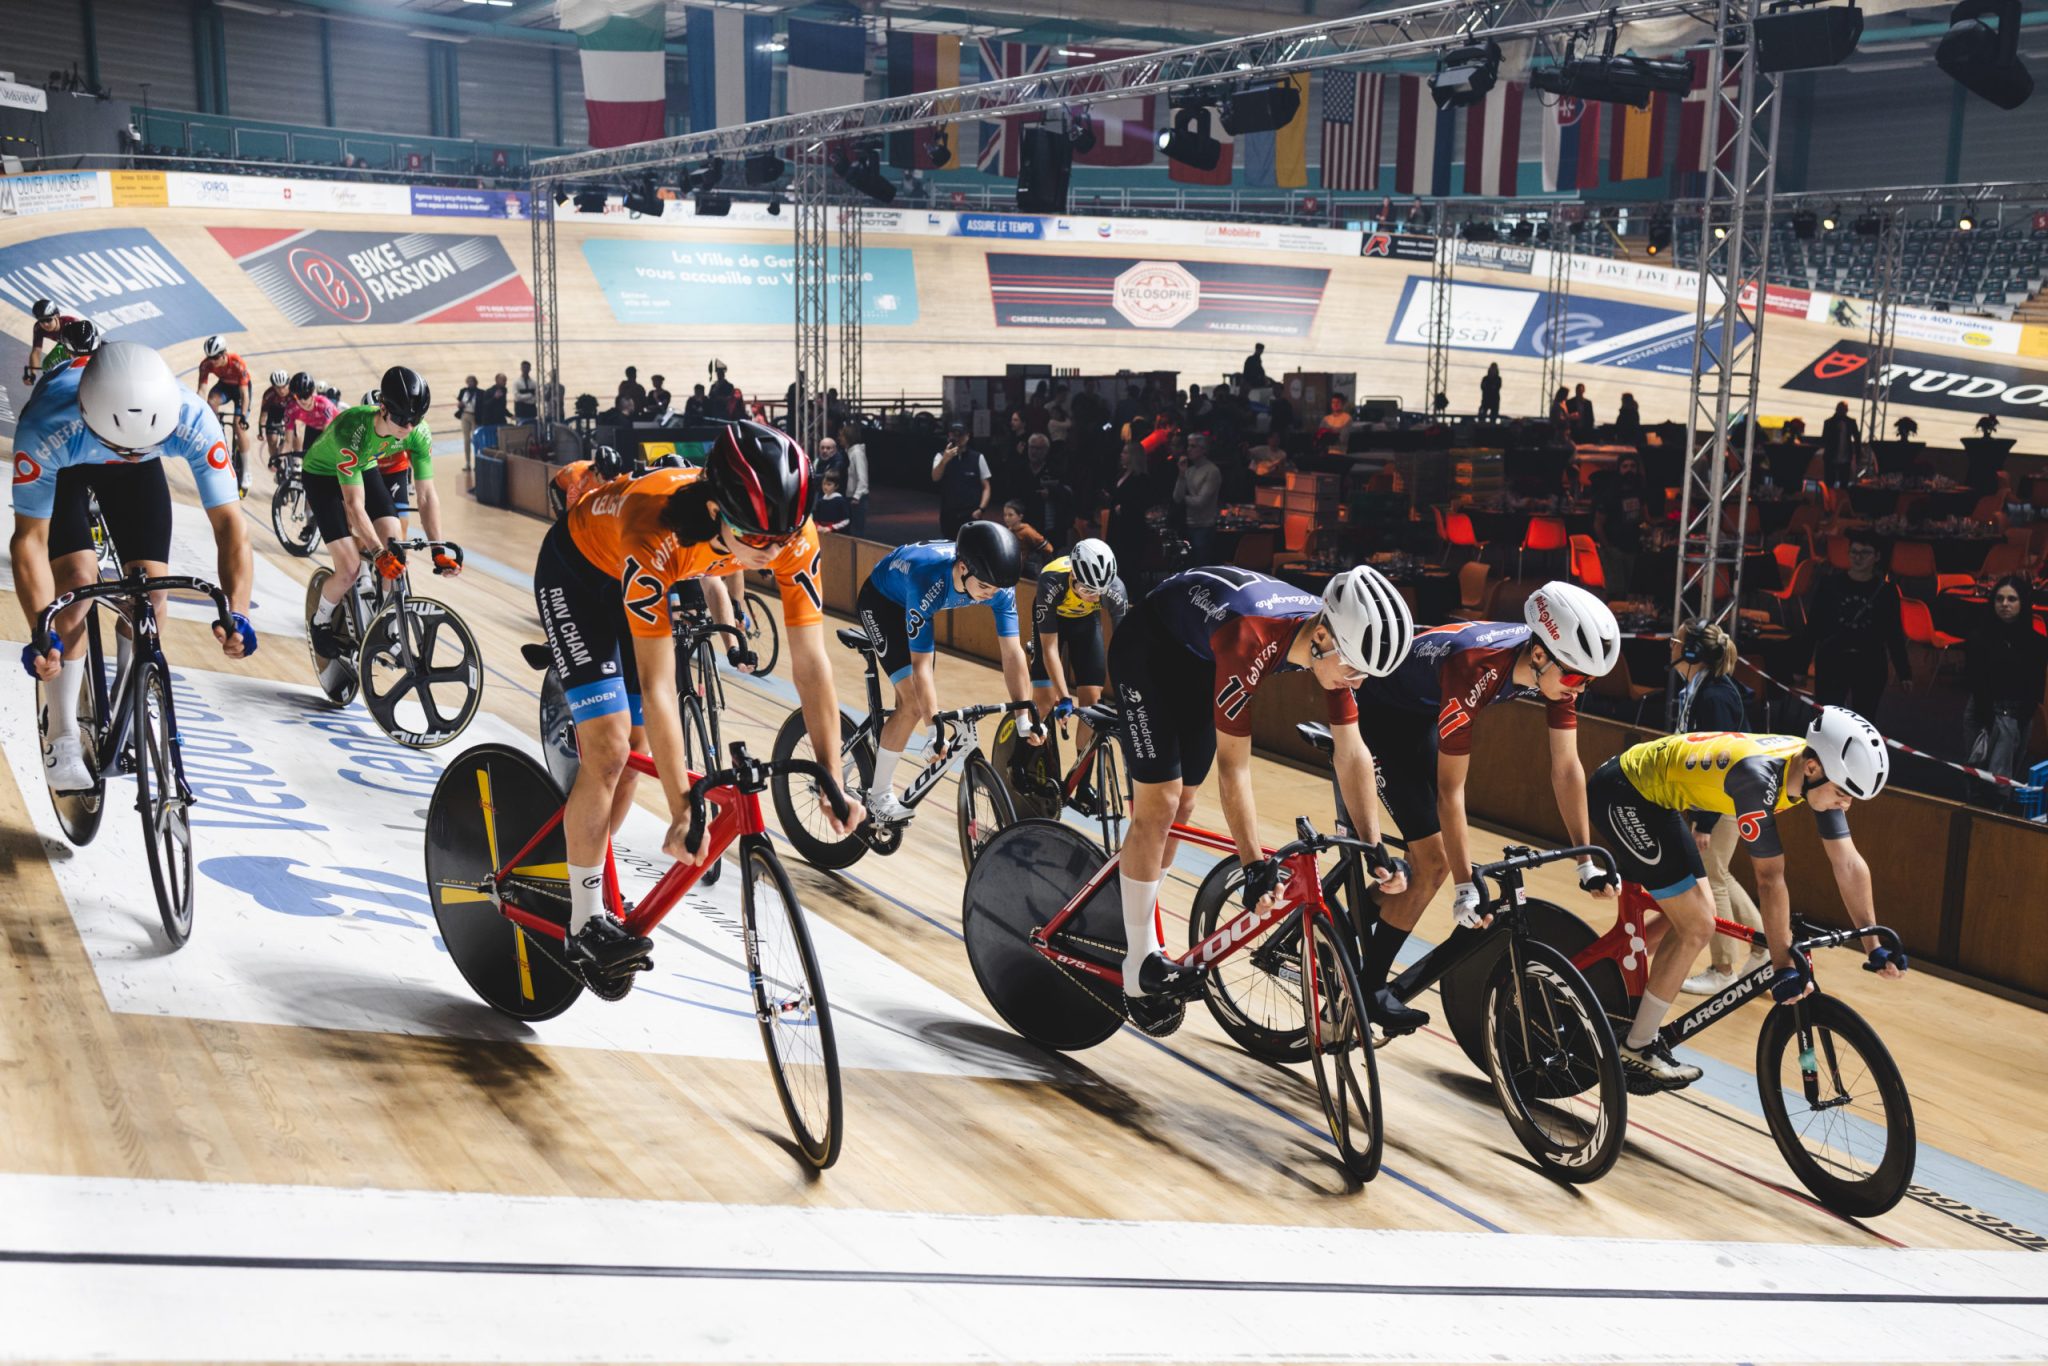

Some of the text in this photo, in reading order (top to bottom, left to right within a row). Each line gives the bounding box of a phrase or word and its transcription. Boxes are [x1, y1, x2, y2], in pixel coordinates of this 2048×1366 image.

[966, 219, 1034, 233] ASSURE LE TEMPO
[348, 242, 404, 280] BIKE
[671, 251, 686, 265] La
[696, 250, 733, 267] Ville
[739, 253, 760, 268] de
[1467, 244, 1498, 258] SPORT
[23, 245, 186, 307] MAULINI
[366, 251, 457, 304] PASSION
[635, 266, 676, 282] vous
[680, 269, 753, 285] accueille
[757, 274, 779, 286] au
[1121, 287, 1192, 301] VELOSOPHE
[1867, 363, 2048, 408] TUDO
[336, 448, 359, 477] 2
[623, 555, 664, 625] 12
[539, 587, 571, 680] HAGENDORN
[549, 587, 593, 667] RMV CHAM
[906, 608, 926, 640] 3
[1215, 675, 1251, 721] 11
[1438, 697, 1471, 740] 11
[1126, 709, 1144, 759] de Genève
[1136, 705, 1157, 759] Vélodrome
[1737, 810, 1768, 842] 6
[1057, 954, 1087, 970] 875
[1682, 964, 1775, 1036] ARGON 18
